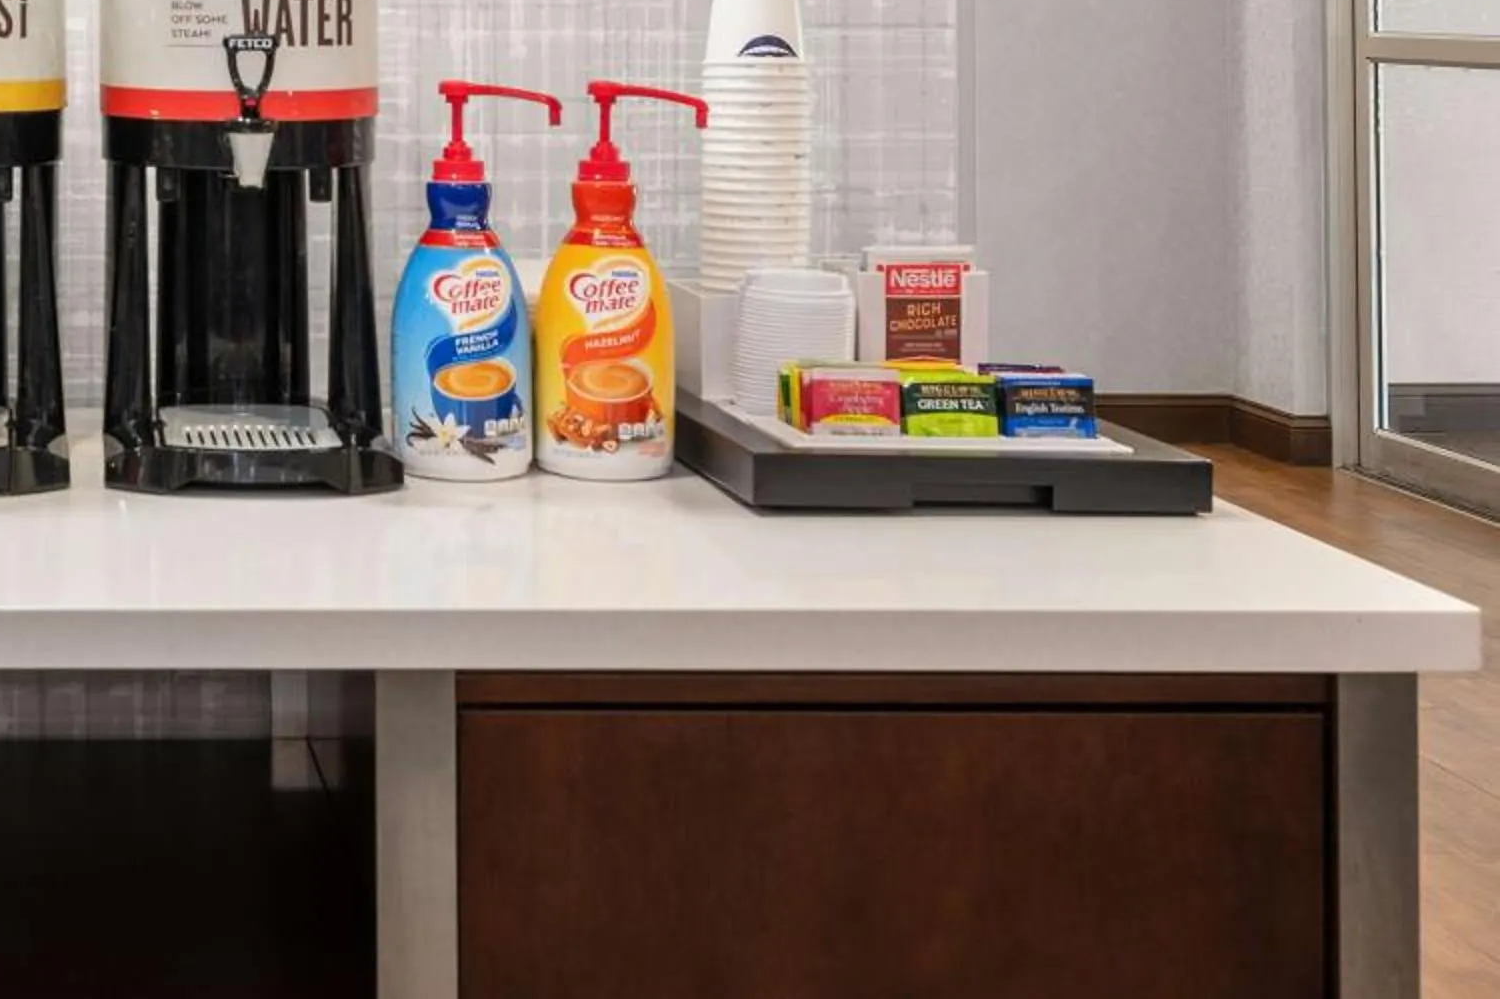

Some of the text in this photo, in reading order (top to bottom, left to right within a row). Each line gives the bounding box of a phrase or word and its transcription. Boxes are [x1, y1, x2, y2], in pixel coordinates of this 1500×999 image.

[229, 38, 272, 49] FETCO
[434, 274, 501, 301] Coffee
[570, 273, 639, 301] Coffee
[452, 296, 500, 313] mate
[585, 296, 636, 313] mate
[907, 302, 942, 316] RICH
[889, 315, 957, 332] CHOCOLATE
[585, 329, 640, 349] HAZELNUT
[917, 398, 985, 410] GREEN TEA
